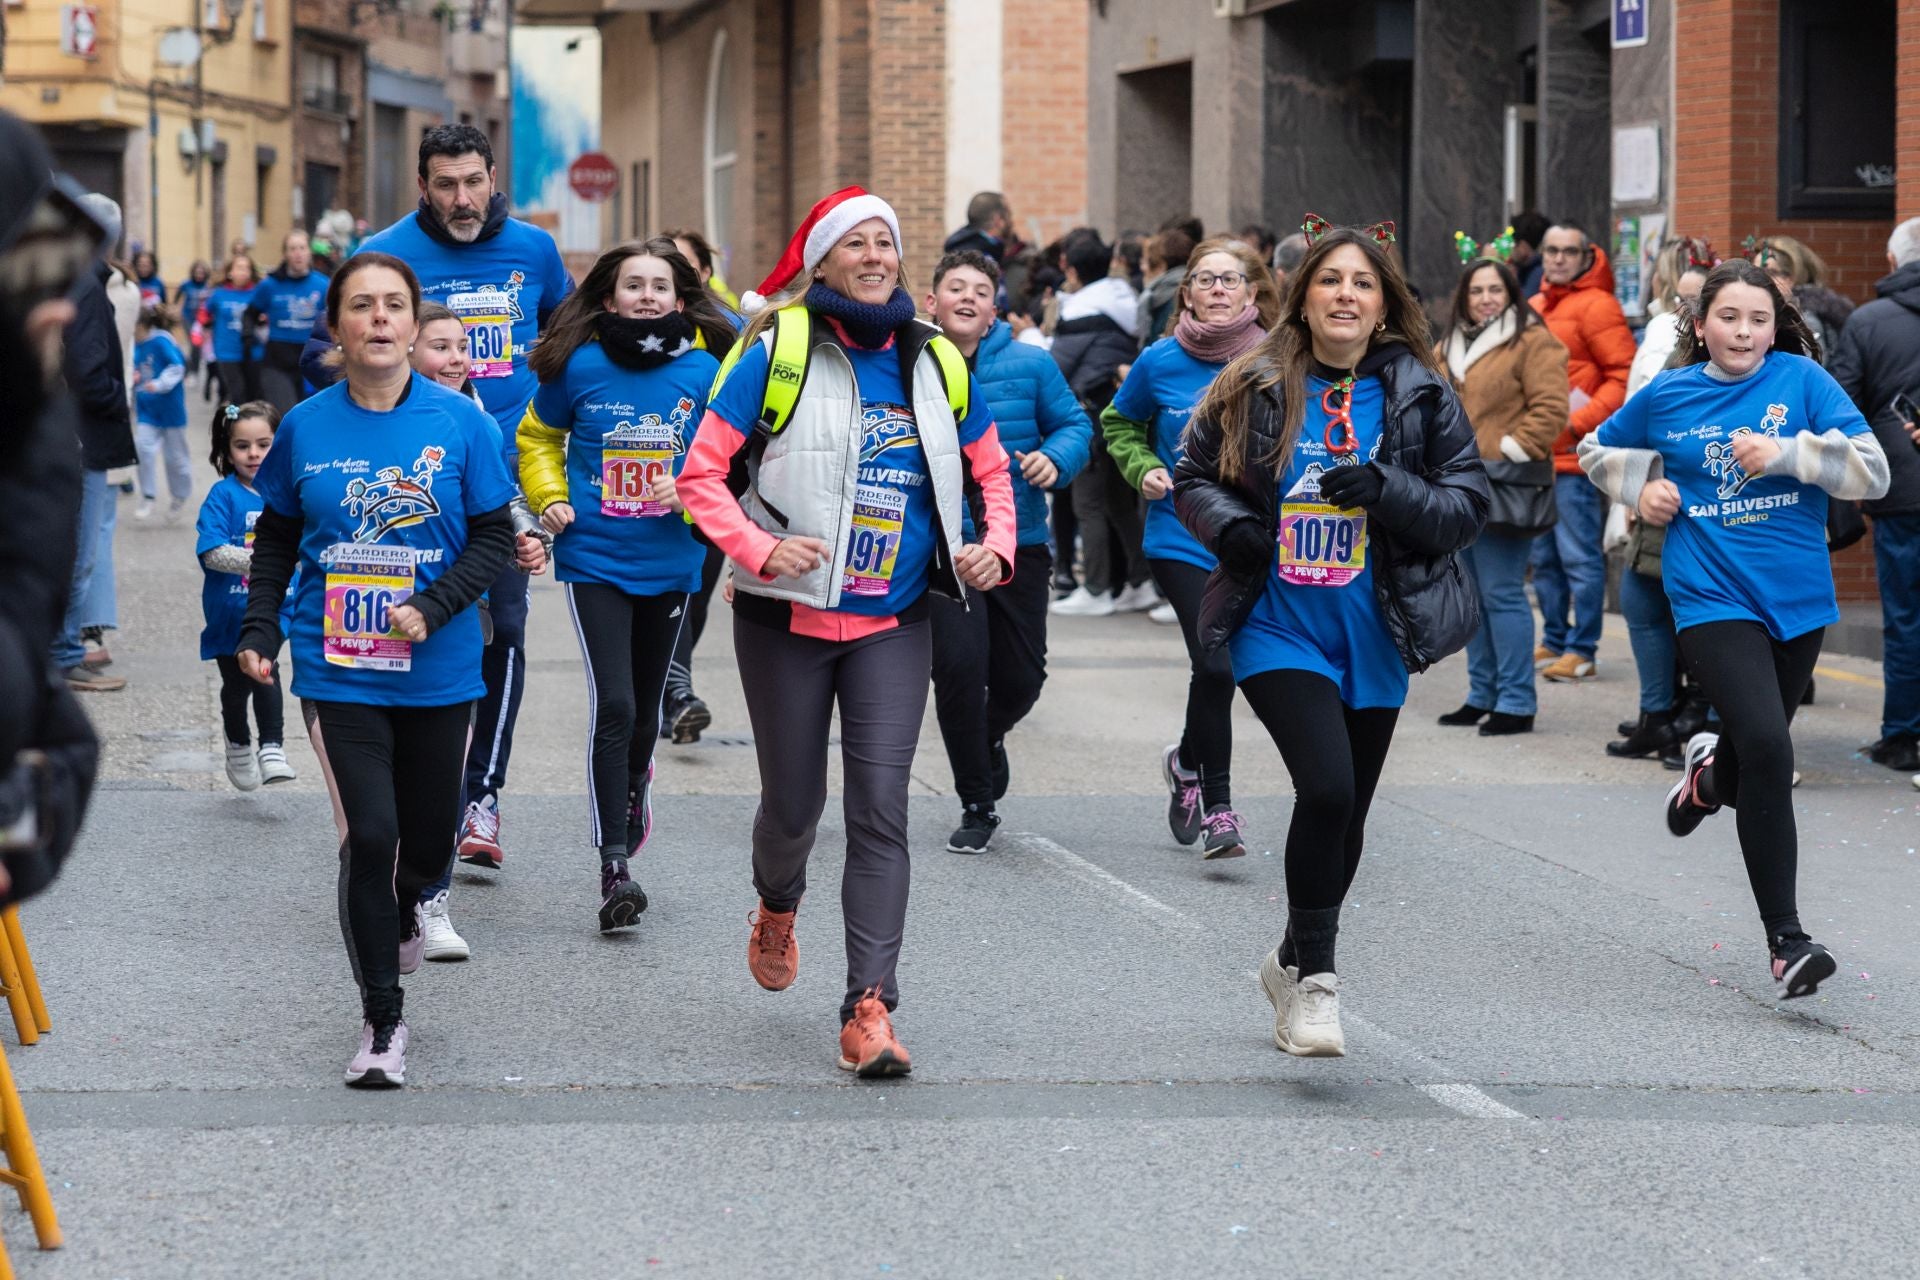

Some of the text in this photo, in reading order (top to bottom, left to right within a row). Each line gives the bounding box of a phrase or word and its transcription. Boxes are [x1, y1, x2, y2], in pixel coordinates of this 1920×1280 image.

[574, 168, 617, 184] STOP
[772, 367, 801, 383] POP!
[609, 440, 624, 448] SAN
[615, 501, 643, 512] PEVISA
[1688, 492, 1799, 518] SAN SILVESTRE
[1722, 512, 1769, 527] Lardero
[1290, 517, 1354, 564] 1079
[339, 555, 411, 563] ayuntamiento
[342, 547, 409, 558] LARDERO
[334, 563, 352, 572] SAN
[1295, 566, 1329, 580] PEVISA
[344, 588, 393, 634] 816
[340, 638, 375, 651] PEVISA
[388, 660, 404, 668] 816
